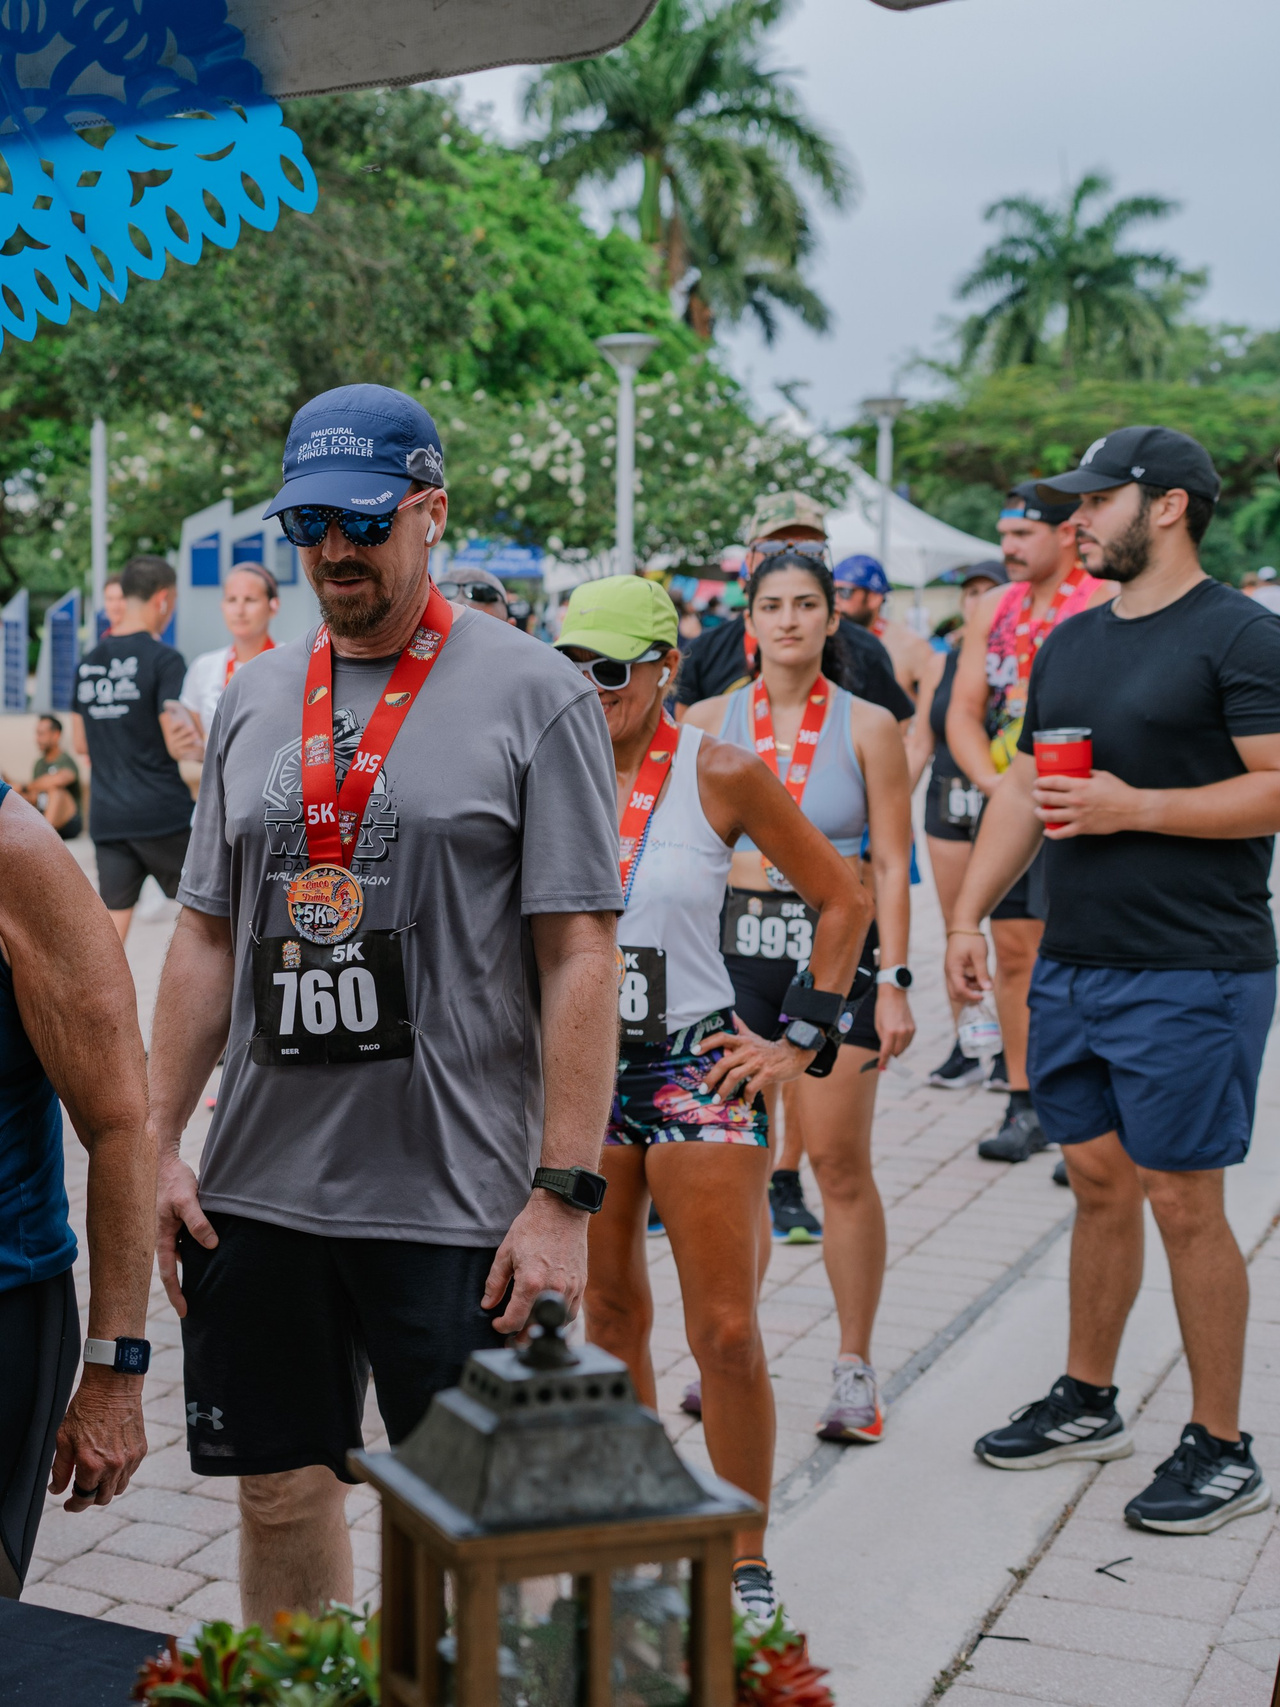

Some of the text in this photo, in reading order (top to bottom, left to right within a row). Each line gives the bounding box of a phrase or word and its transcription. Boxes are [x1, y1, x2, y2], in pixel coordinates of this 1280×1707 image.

[310, 427, 355, 439] INAUGURAL
[298, 436, 374, 455] SPACE FORCE
[297, 447, 374, 465] T-MINUS 10-MILER
[351, 490, 394, 506] SEMPER SUPRA
[313, 628, 329, 653] 5K
[352, 751, 382, 774] 5K
[630, 791, 654, 810] 5K
[307, 802, 336, 825] 5K
[303, 904, 328, 924] 5K
[781, 903, 806, 918] 5K
[736, 914, 813, 960] 993
[331, 942, 365, 963] 5K
[625, 953, 640, 969] K
[273, 967, 379, 1035] 760
[620, 972, 649, 1022] 8
[359, 1043, 380, 1051] TACO
